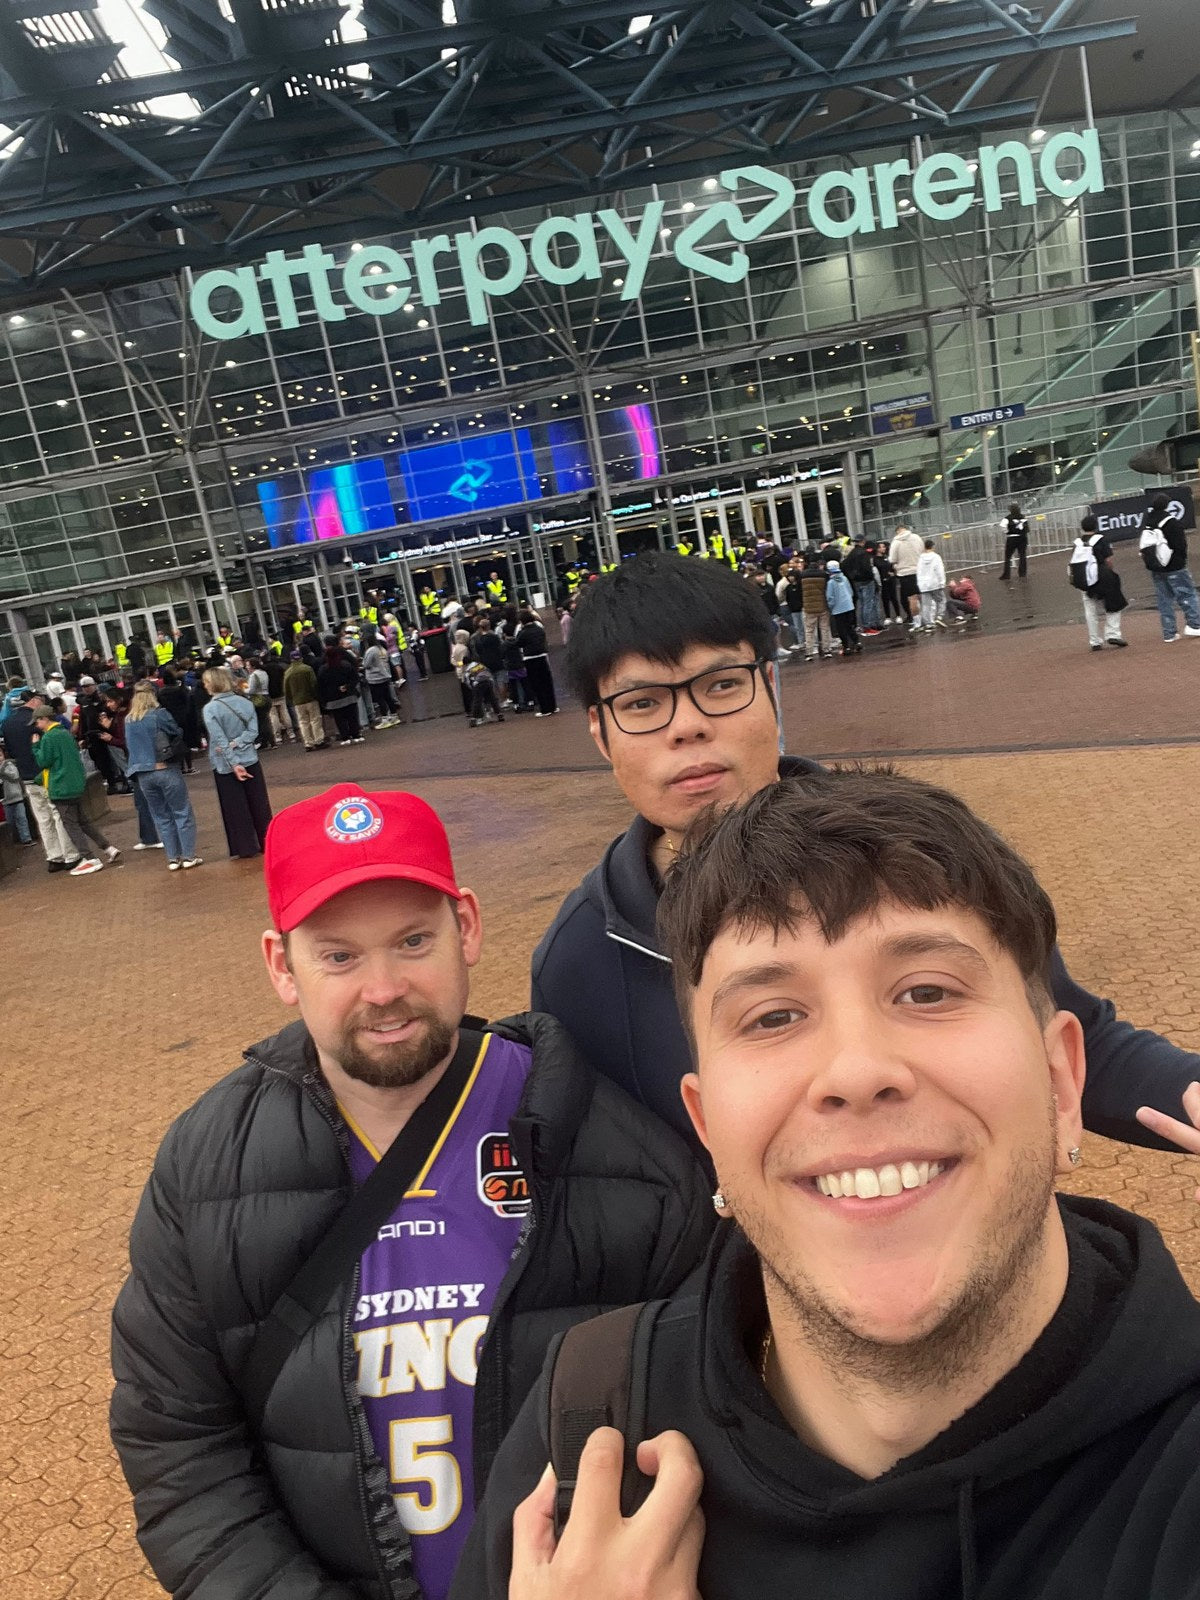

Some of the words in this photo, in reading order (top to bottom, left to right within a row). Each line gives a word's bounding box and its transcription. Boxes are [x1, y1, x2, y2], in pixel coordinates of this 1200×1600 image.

[807, 128, 1105, 239] arena
[961, 413, 993, 426] ENTRY
[995, 409, 1004, 420] B
[541, 520, 566, 529] Coffee
[1097, 512, 1144, 532] Entry
[398, 547, 424, 558] Sydney
[424, 543, 445, 553] Kings
[445, 537, 480, 548] Members
[334, 796, 369, 809] SURF
[327, 825, 349, 841] LIFE
[349, 818, 381, 841] SAVING
[378, 1220, 446, 1241] AND1
[354, 1283, 485, 1322] SYDNEY
[353, 1314, 491, 1398] ING
[389, 1414, 463, 1535] 5
